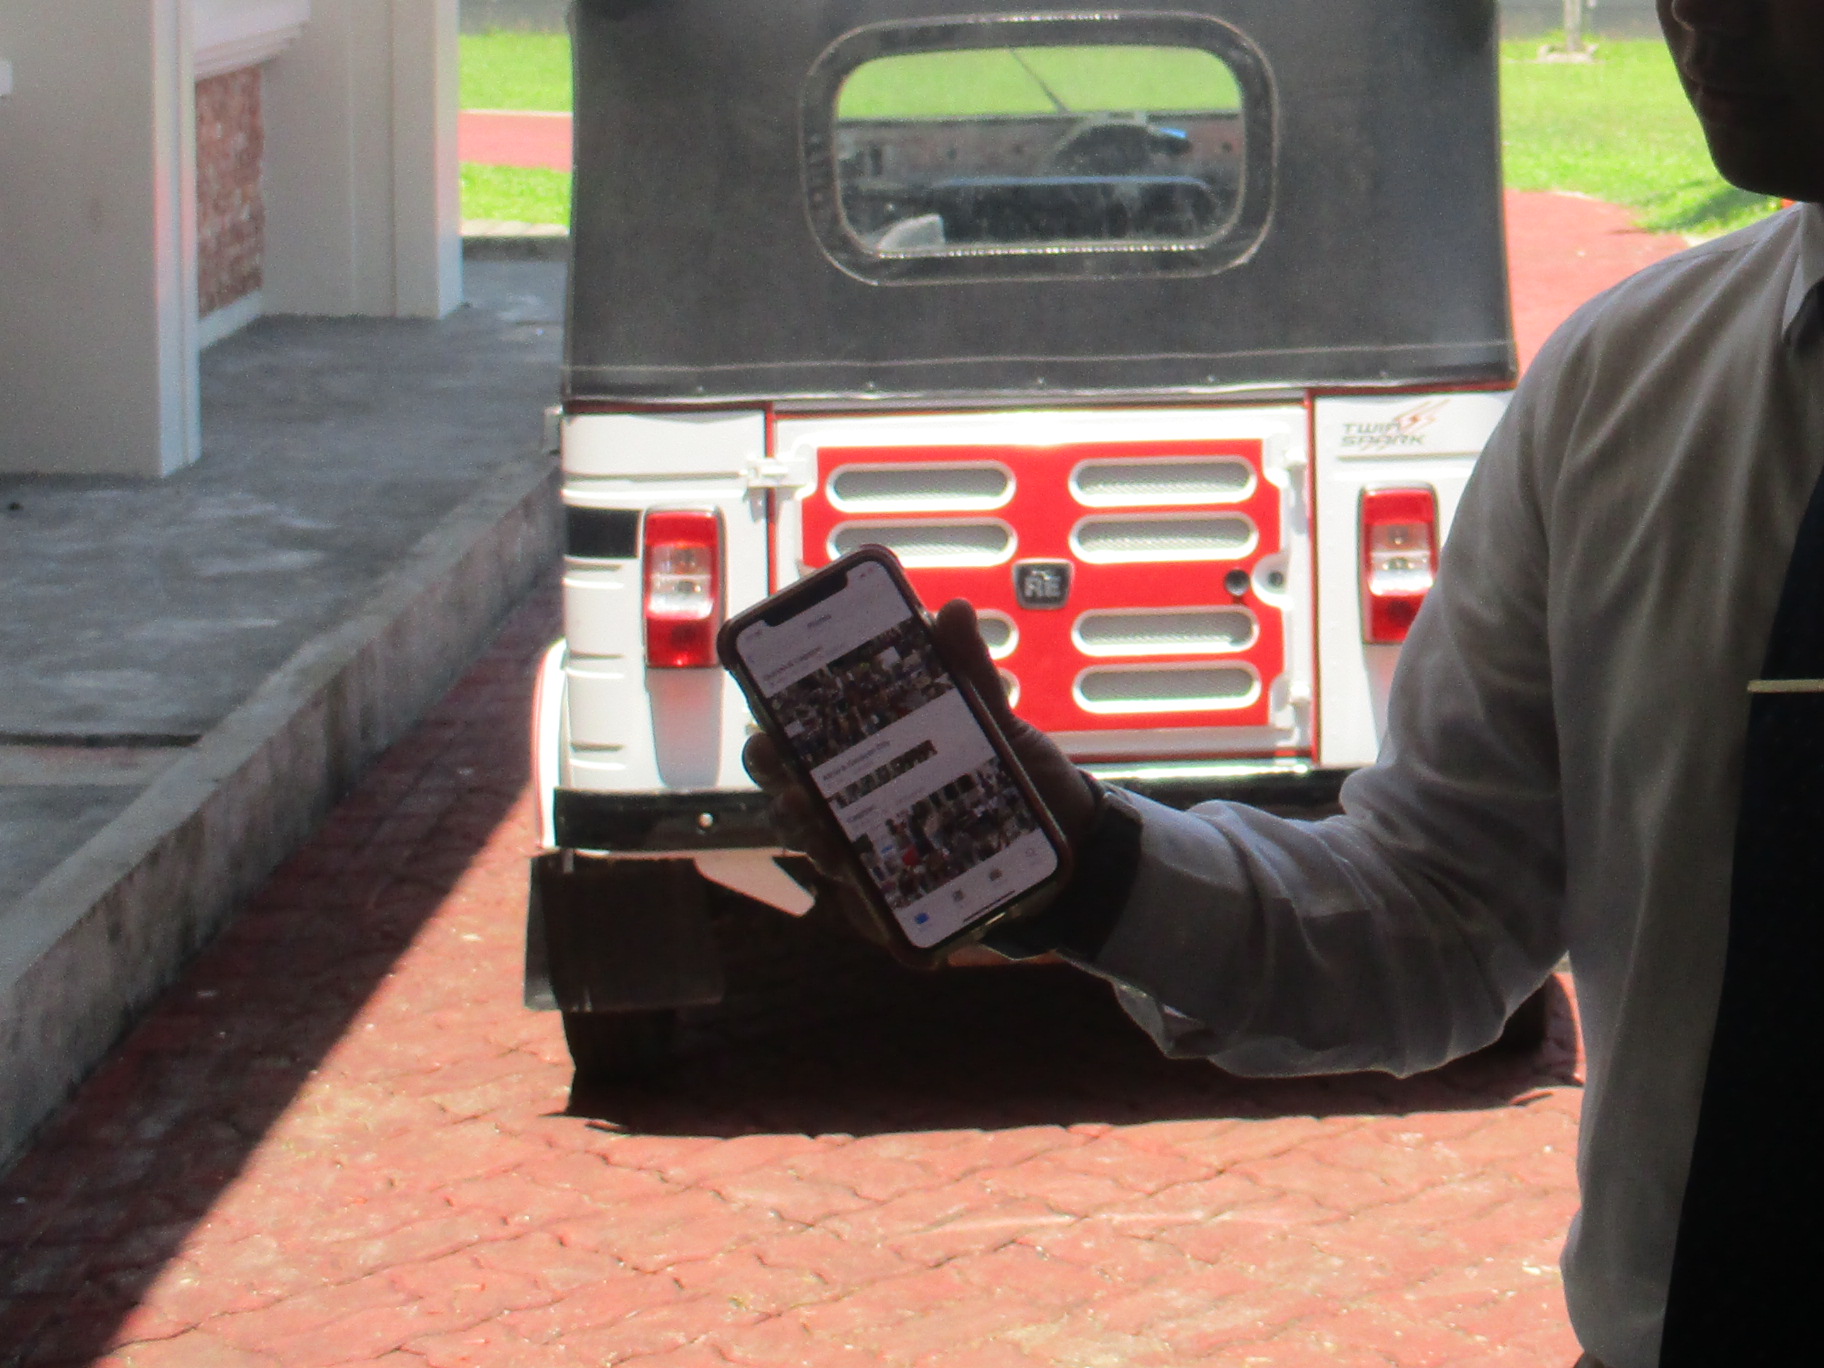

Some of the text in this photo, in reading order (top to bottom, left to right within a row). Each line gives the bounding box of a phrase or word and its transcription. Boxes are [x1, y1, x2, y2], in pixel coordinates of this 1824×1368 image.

[1342, 422, 1402, 435] TWIN
[1341, 434, 1425, 447] SPARK
[1024, 575, 1062, 598] RE
